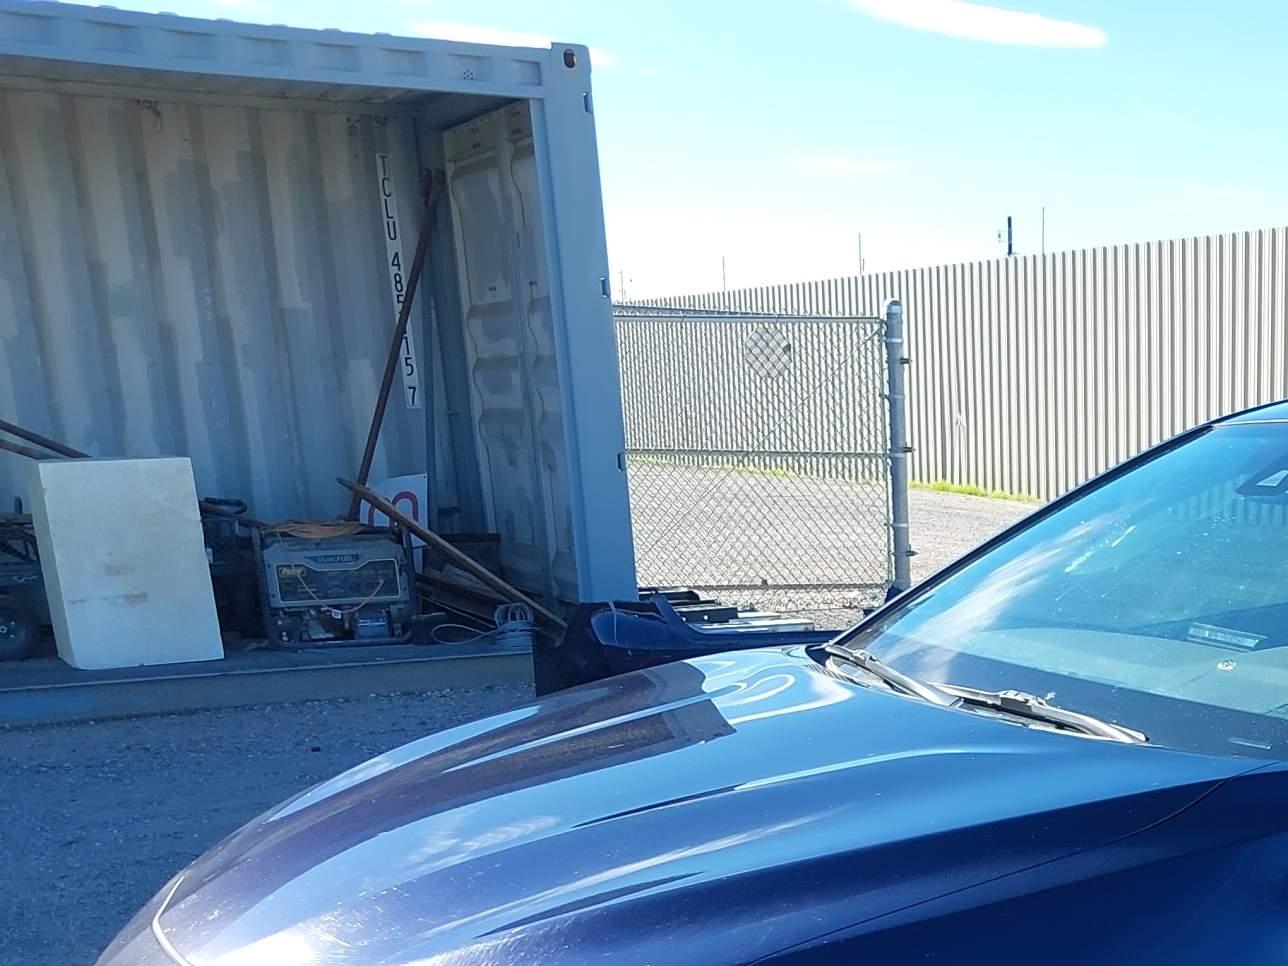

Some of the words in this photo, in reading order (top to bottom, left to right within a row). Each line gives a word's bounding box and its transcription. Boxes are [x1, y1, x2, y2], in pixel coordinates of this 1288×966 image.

[378, 154, 398, 241] TCLU
[391, 251, 415, 377] 48515
[407, 386, 417, 406] 7
